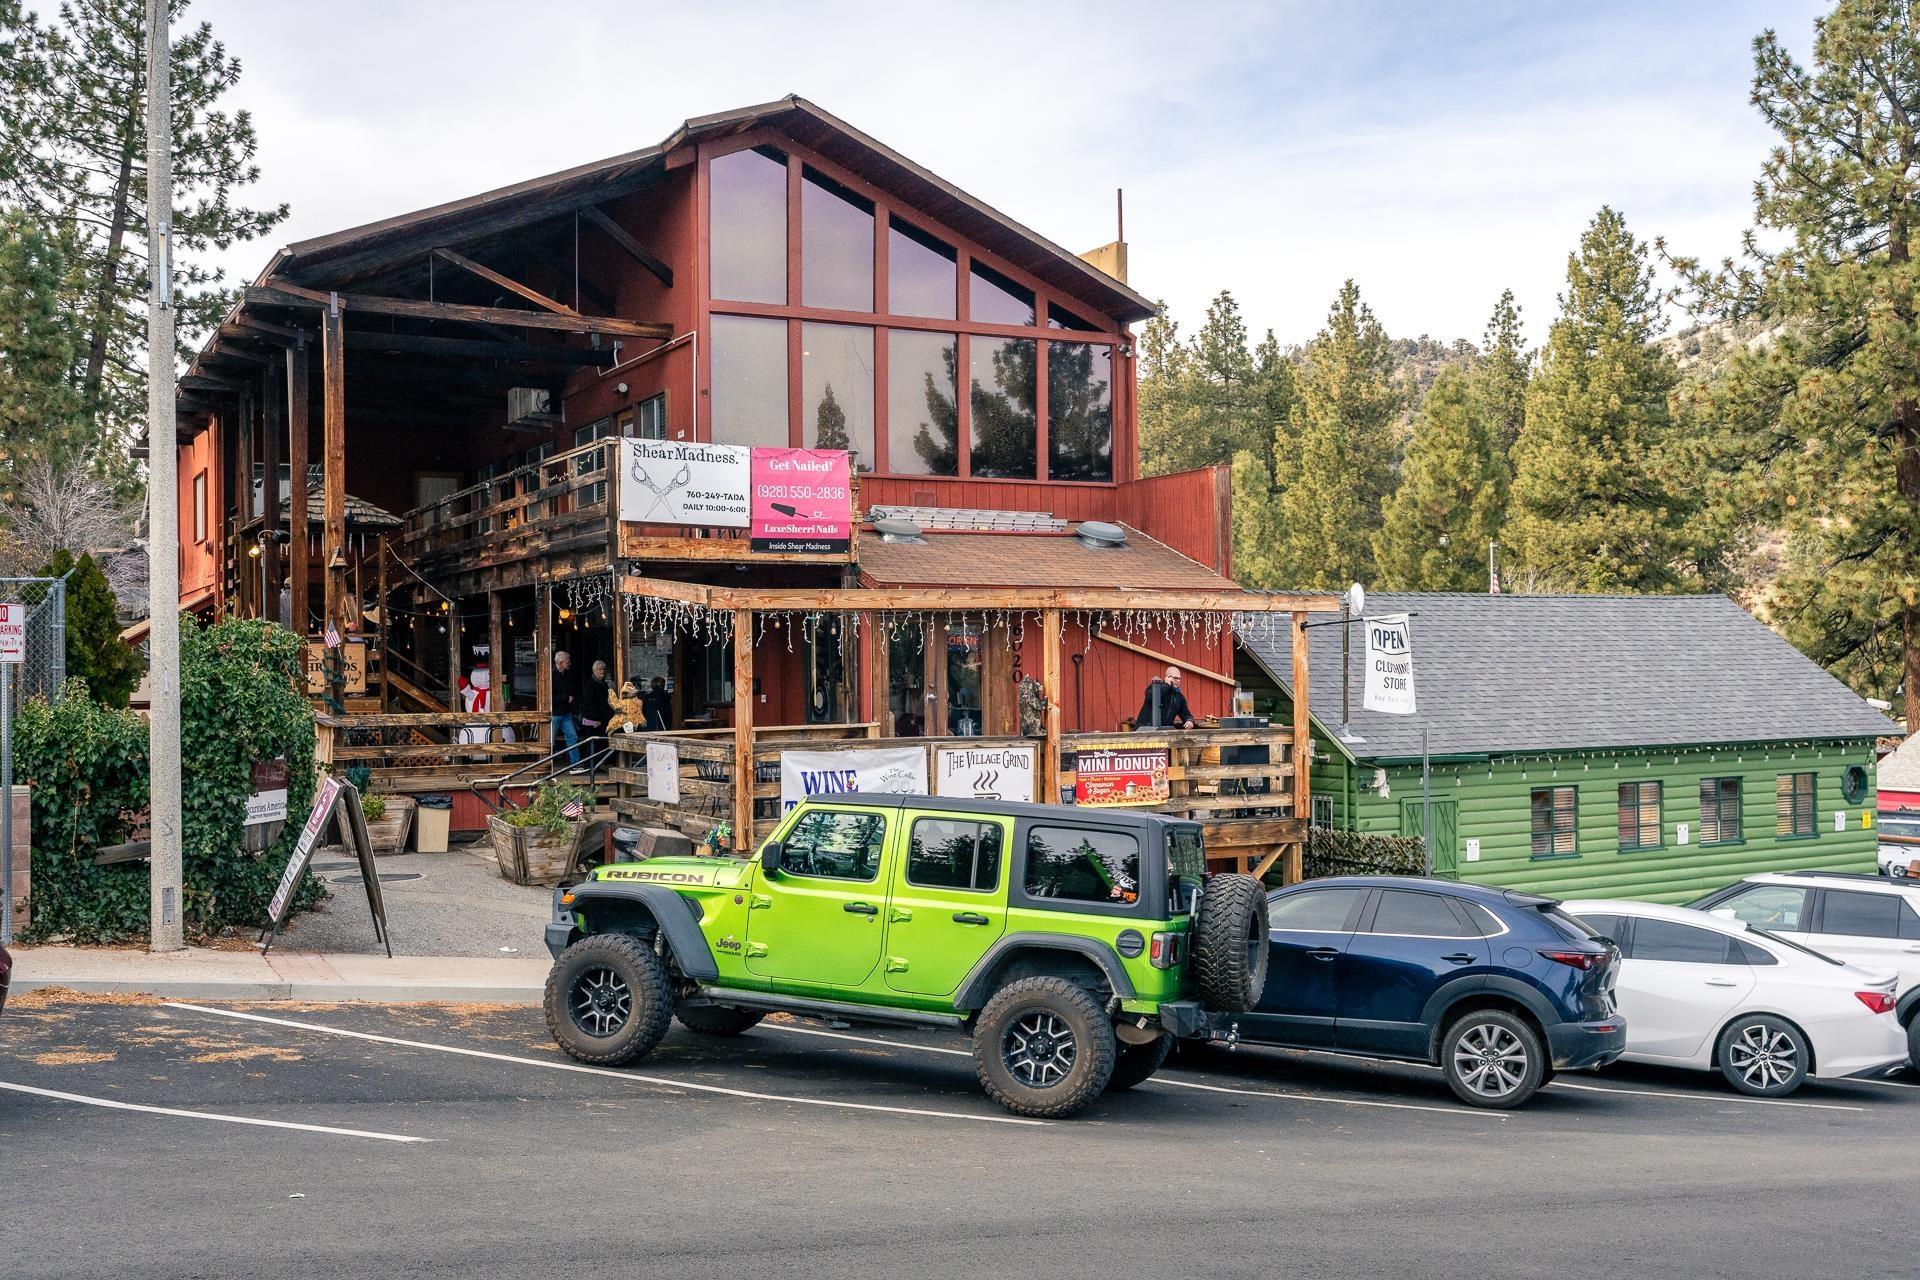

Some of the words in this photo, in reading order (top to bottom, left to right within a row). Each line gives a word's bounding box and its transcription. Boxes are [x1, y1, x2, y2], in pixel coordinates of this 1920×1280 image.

[769, 459, 791, 471] Get
[792, 460, 833, 472] Nailed!
[686, 490, 745, 501] 760-249-TADA
[757, 485, 787, 498] (928)
[790, 485, 845, 499] 550-2836
[682, 503, 704, 511] DAILY
[705, 504, 746, 513] 10:00-6:00
[816, 524, 838, 534] Nails
[768, 542, 787, 550] Inside
[787, 542, 805, 550] Shear
[805, 542, 831, 550] Madness
[0, 624, 22, 635] ARKING
[948, 636, 977, 646] OPEN
[1373, 628, 1405, 650] OPEN
[1383, 676, 1407, 691] STORE
[1078, 758, 1110, 772] MINI
[1114, 756, 1166, 771] DONUTS
[800, 769, 859, 795] WINE
[1093, 787, 1111, 796] Sugar
[606, 870, 704, 883] RUBICON
[715, 938, 741, 951] Jeep
